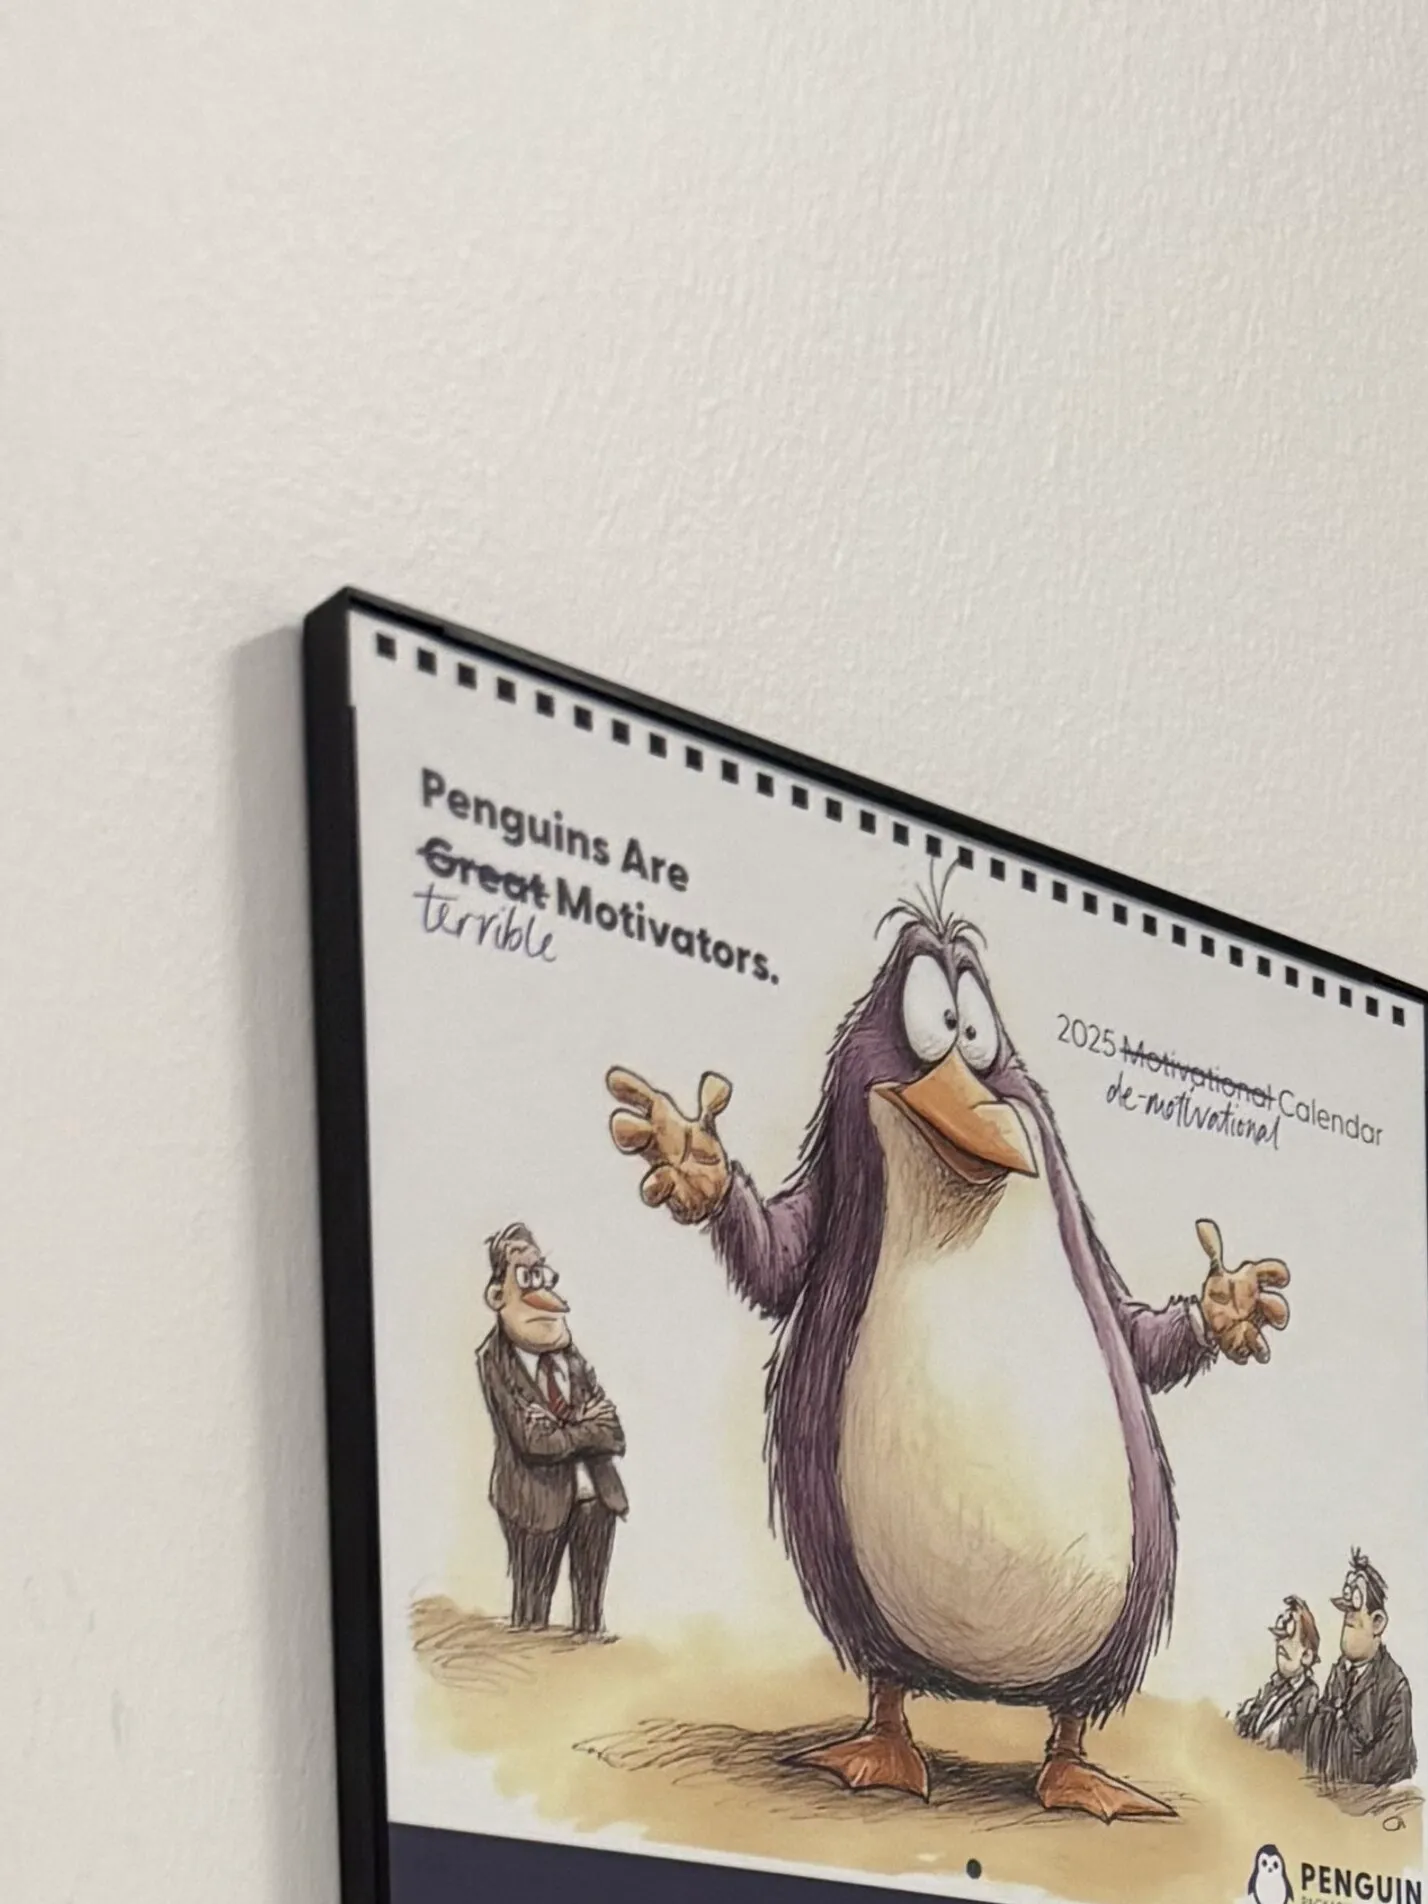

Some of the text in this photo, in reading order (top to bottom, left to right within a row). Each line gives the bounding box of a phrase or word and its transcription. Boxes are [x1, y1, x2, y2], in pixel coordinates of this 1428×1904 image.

[421, 767, 690, 892] Penguins Are
[413, 882, 557, 963] terrible
[556, 876, 779, 985] Motivators.
[1057, 1013, 1117, 1058] 2025
[1278, 1089, 1384, 1146] Calendar
